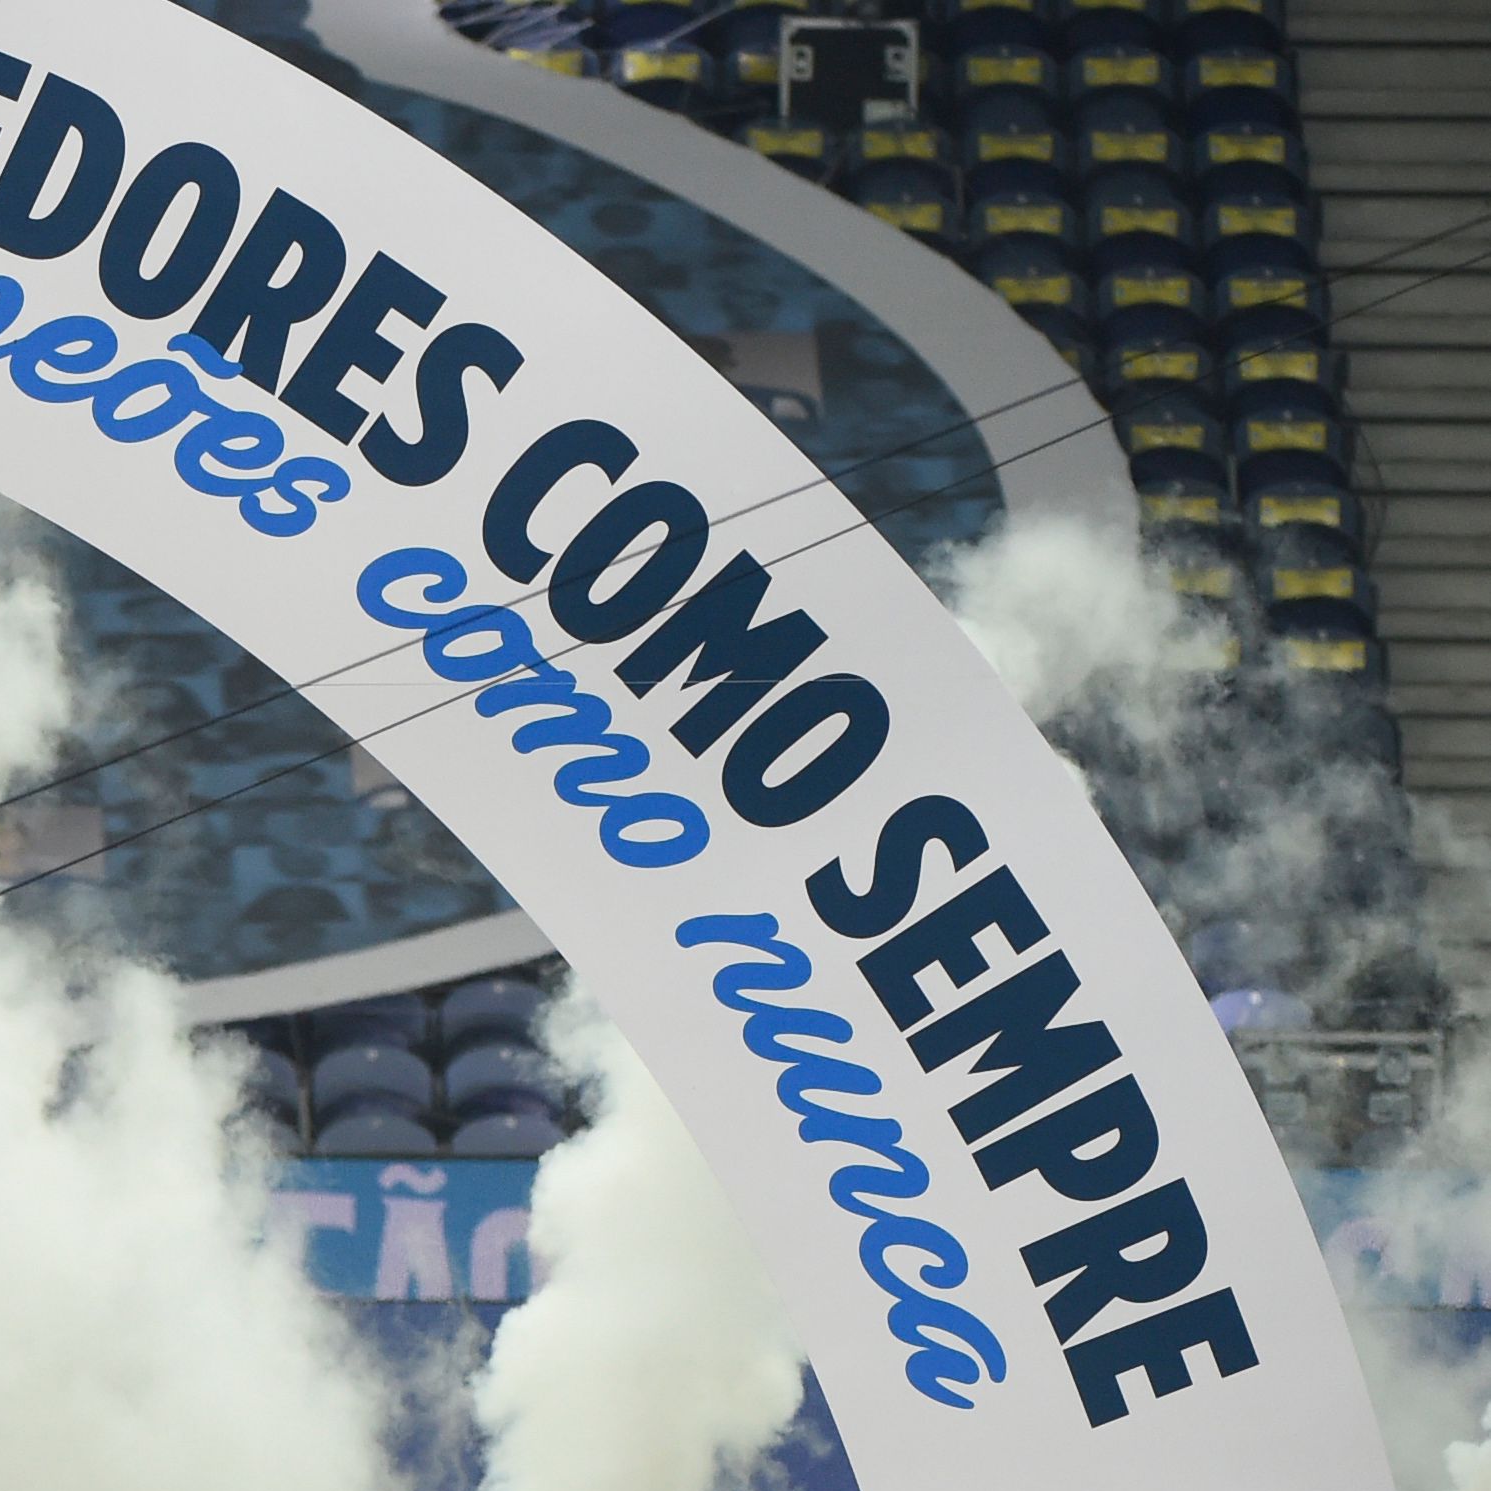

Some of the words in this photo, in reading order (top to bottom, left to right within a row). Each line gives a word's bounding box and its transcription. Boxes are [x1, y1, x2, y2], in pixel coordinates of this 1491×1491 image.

[356, 546, 711, 869] como
[674, 911, 1007, 1410] nunca
[483, 418, 891, 828] COMO
[804, 794, 1260, 1428] SEMPRE
